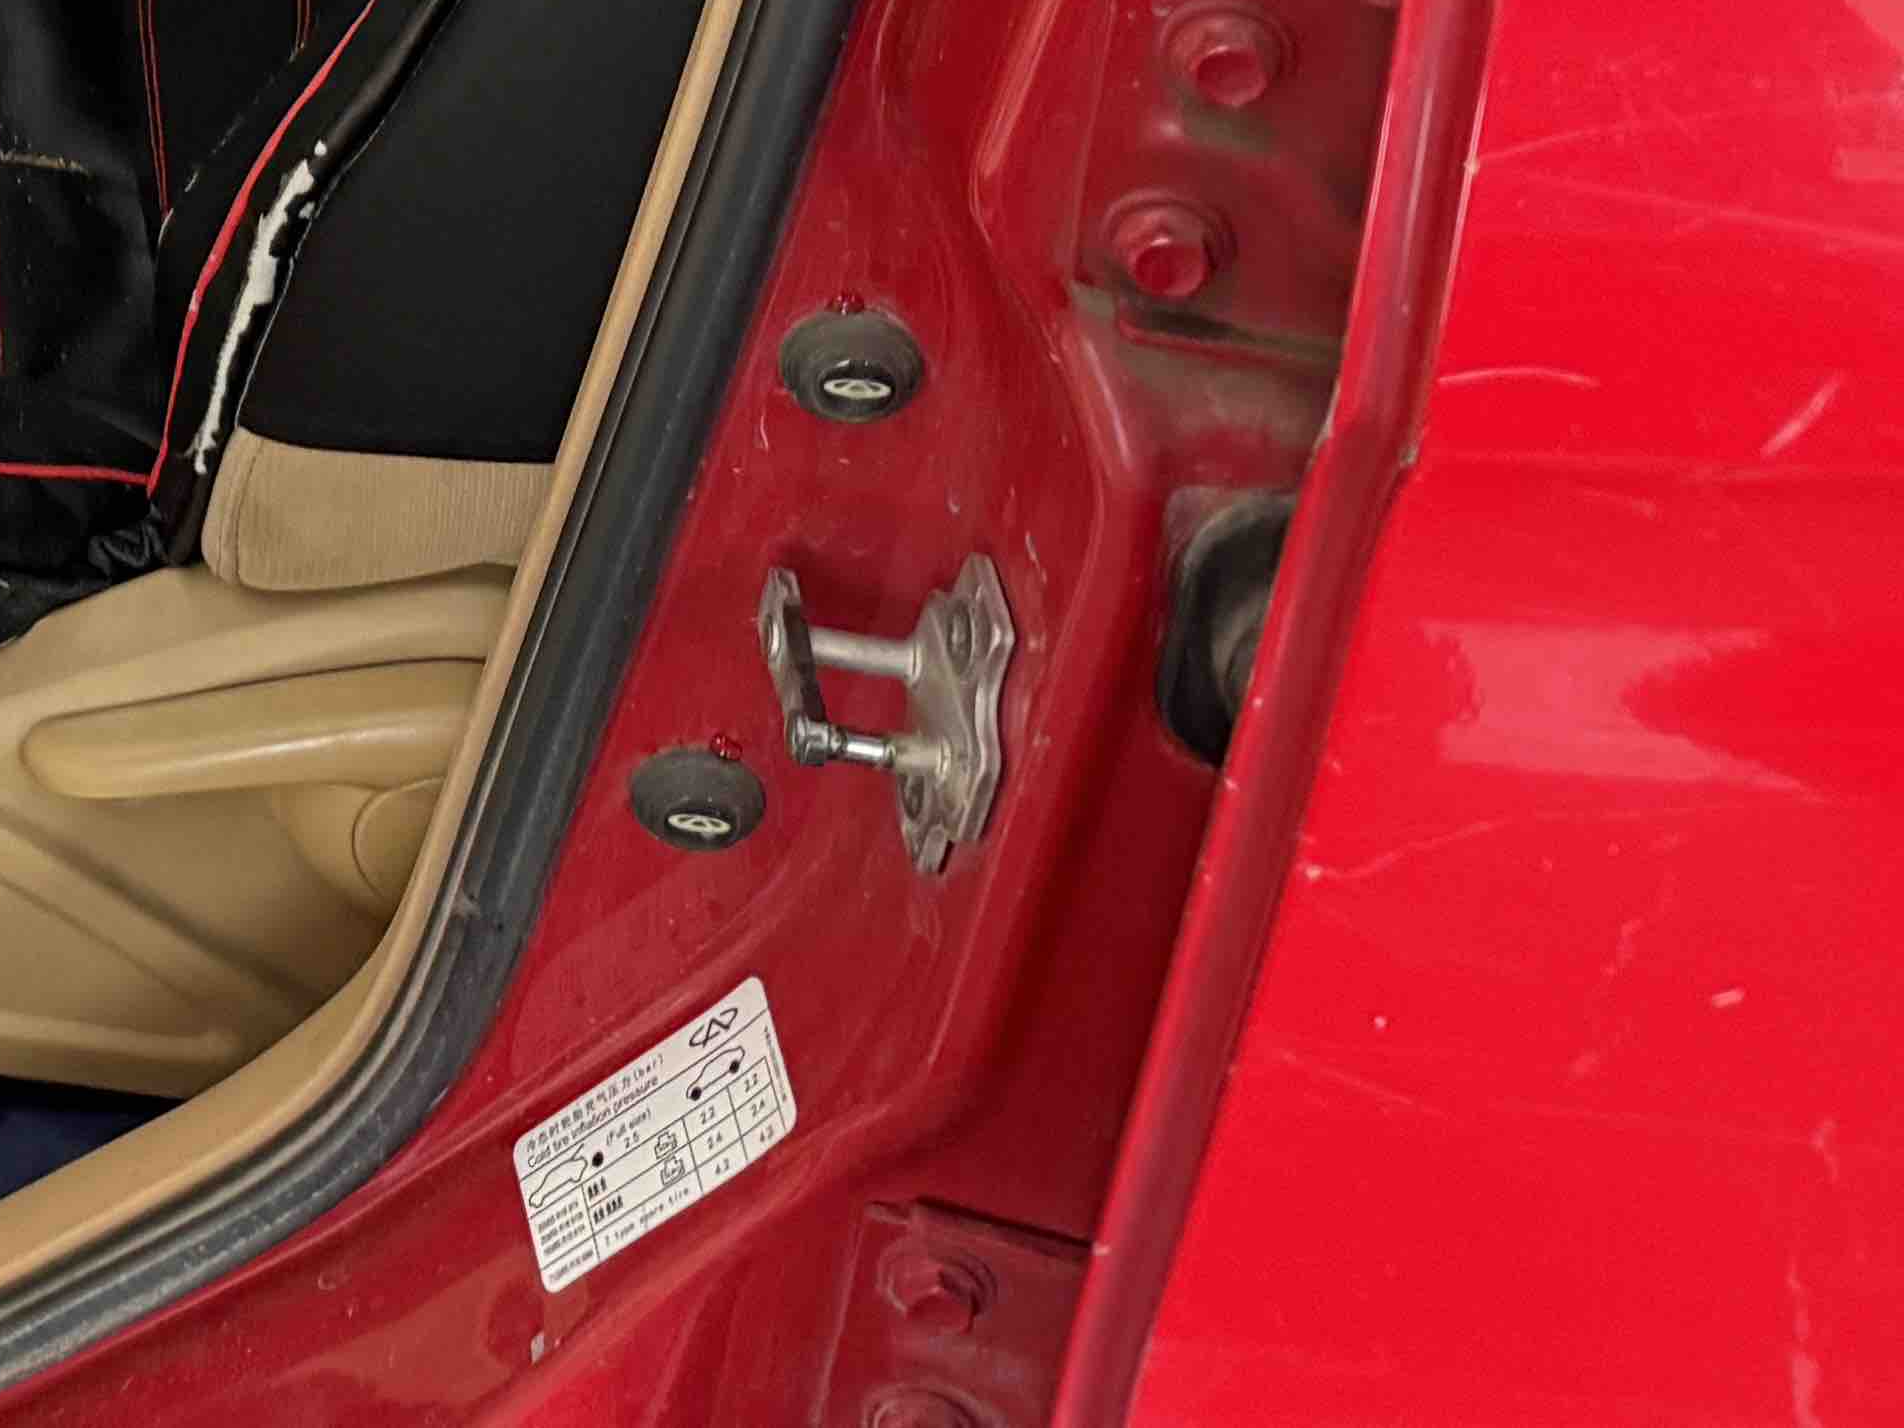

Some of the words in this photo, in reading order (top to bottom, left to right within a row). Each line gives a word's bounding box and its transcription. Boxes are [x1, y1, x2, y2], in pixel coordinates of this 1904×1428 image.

[527, 1143, 551, 1169] Cold
[570, 1104, 610, 1140] inflation
[612, 1072, 659, 1113] pressure
